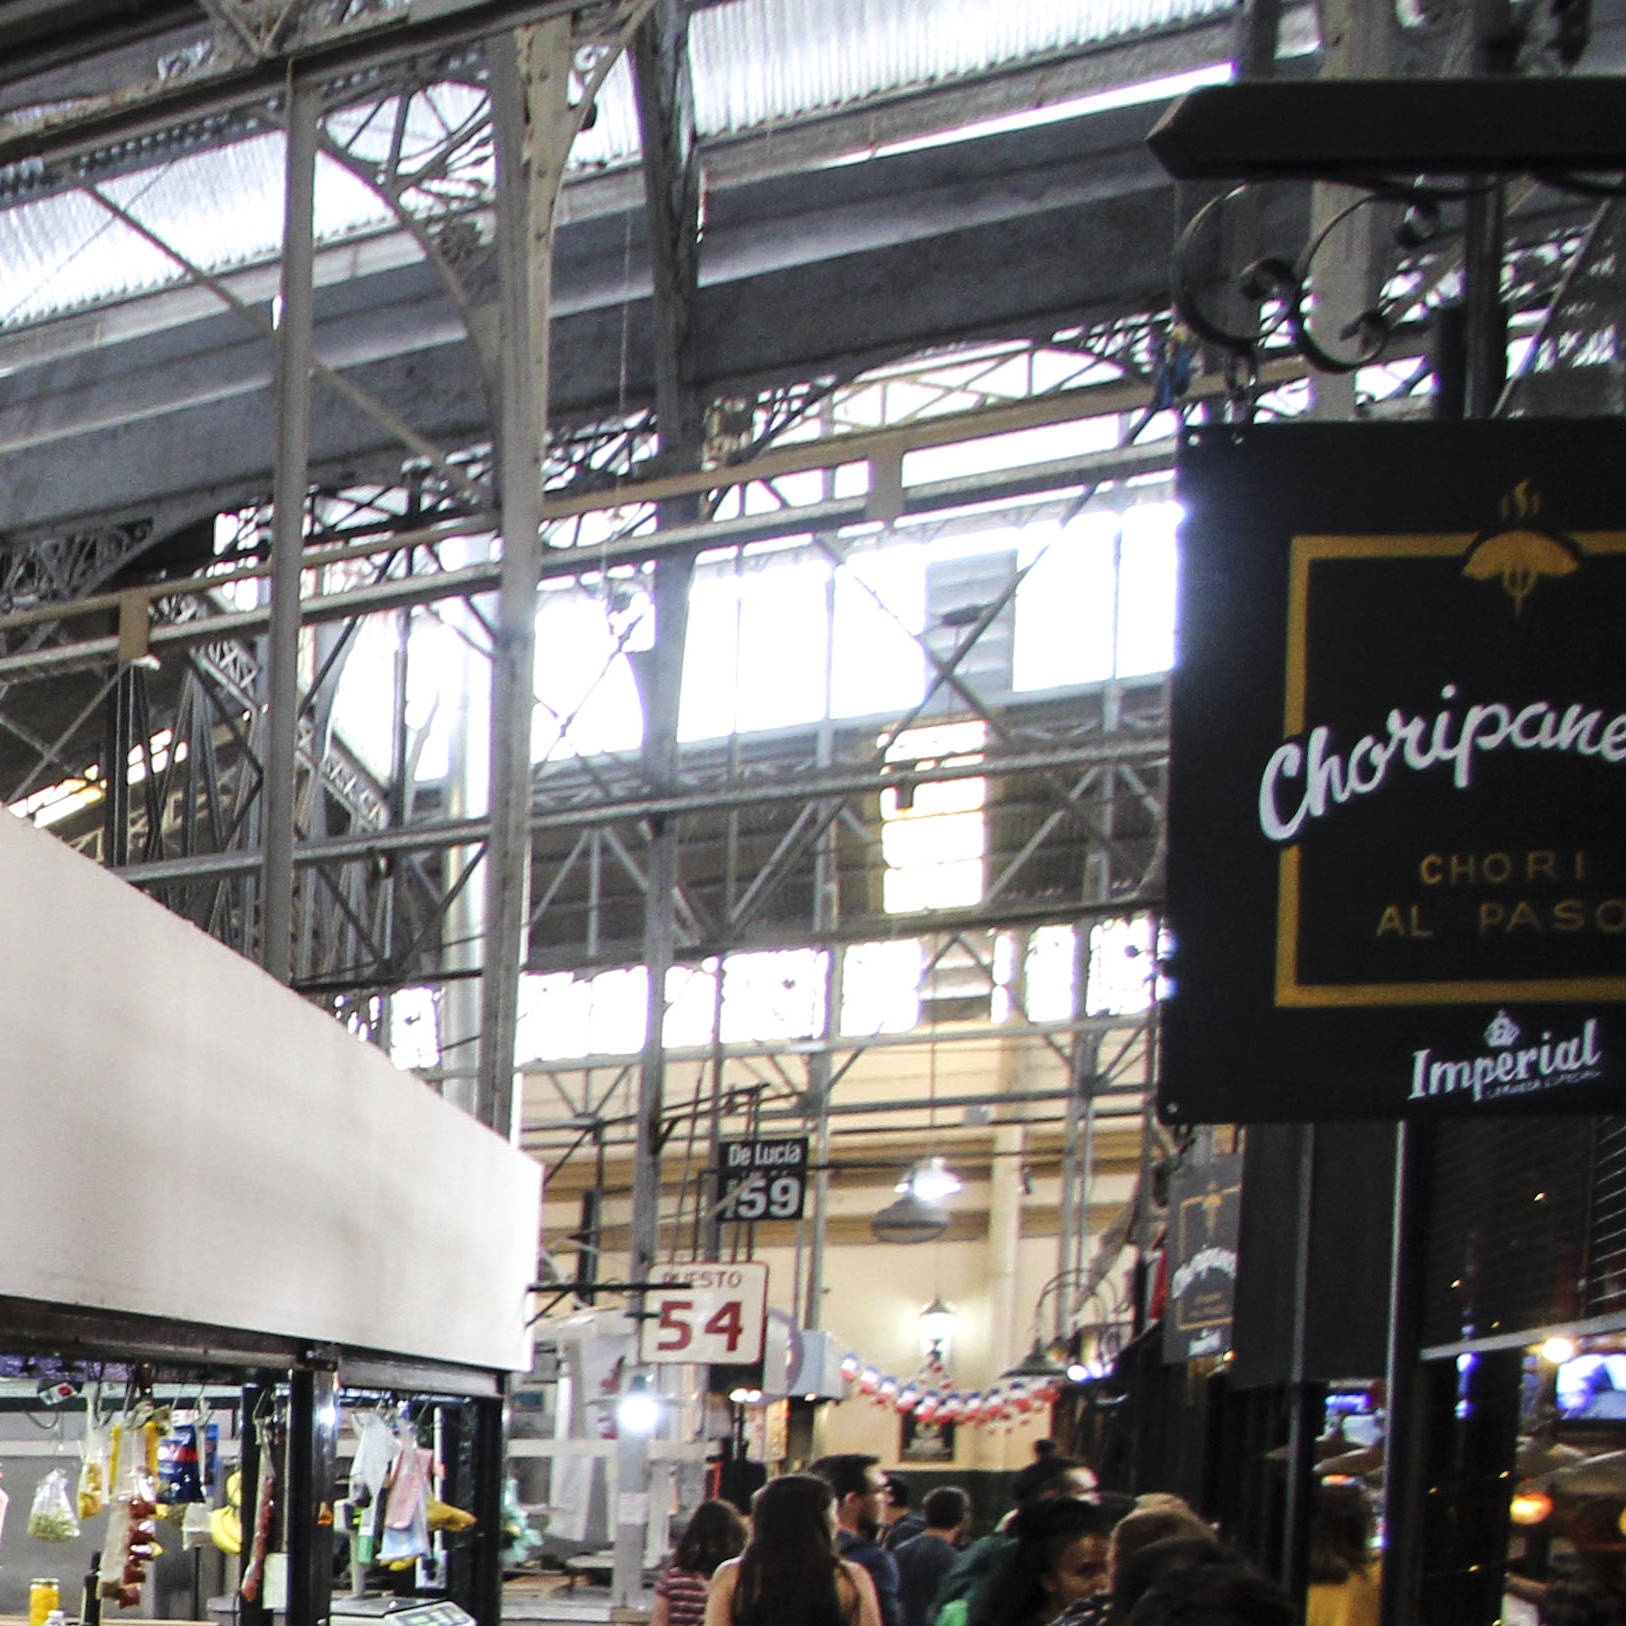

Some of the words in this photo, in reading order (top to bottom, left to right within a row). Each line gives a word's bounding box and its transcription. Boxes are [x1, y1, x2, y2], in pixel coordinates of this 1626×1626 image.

[1419, 851, 1586, 885] CHORI
[1376, 903, 1435, 937] AL
[1479, 899, 1626, 937] PASO
[1407, 1017, 1603, 1102] Imperial
[727, 1143, 751, 1167] De
[754, 1139, 802, 1166] Lucía
[657, 1300, 744, 1352] 54
